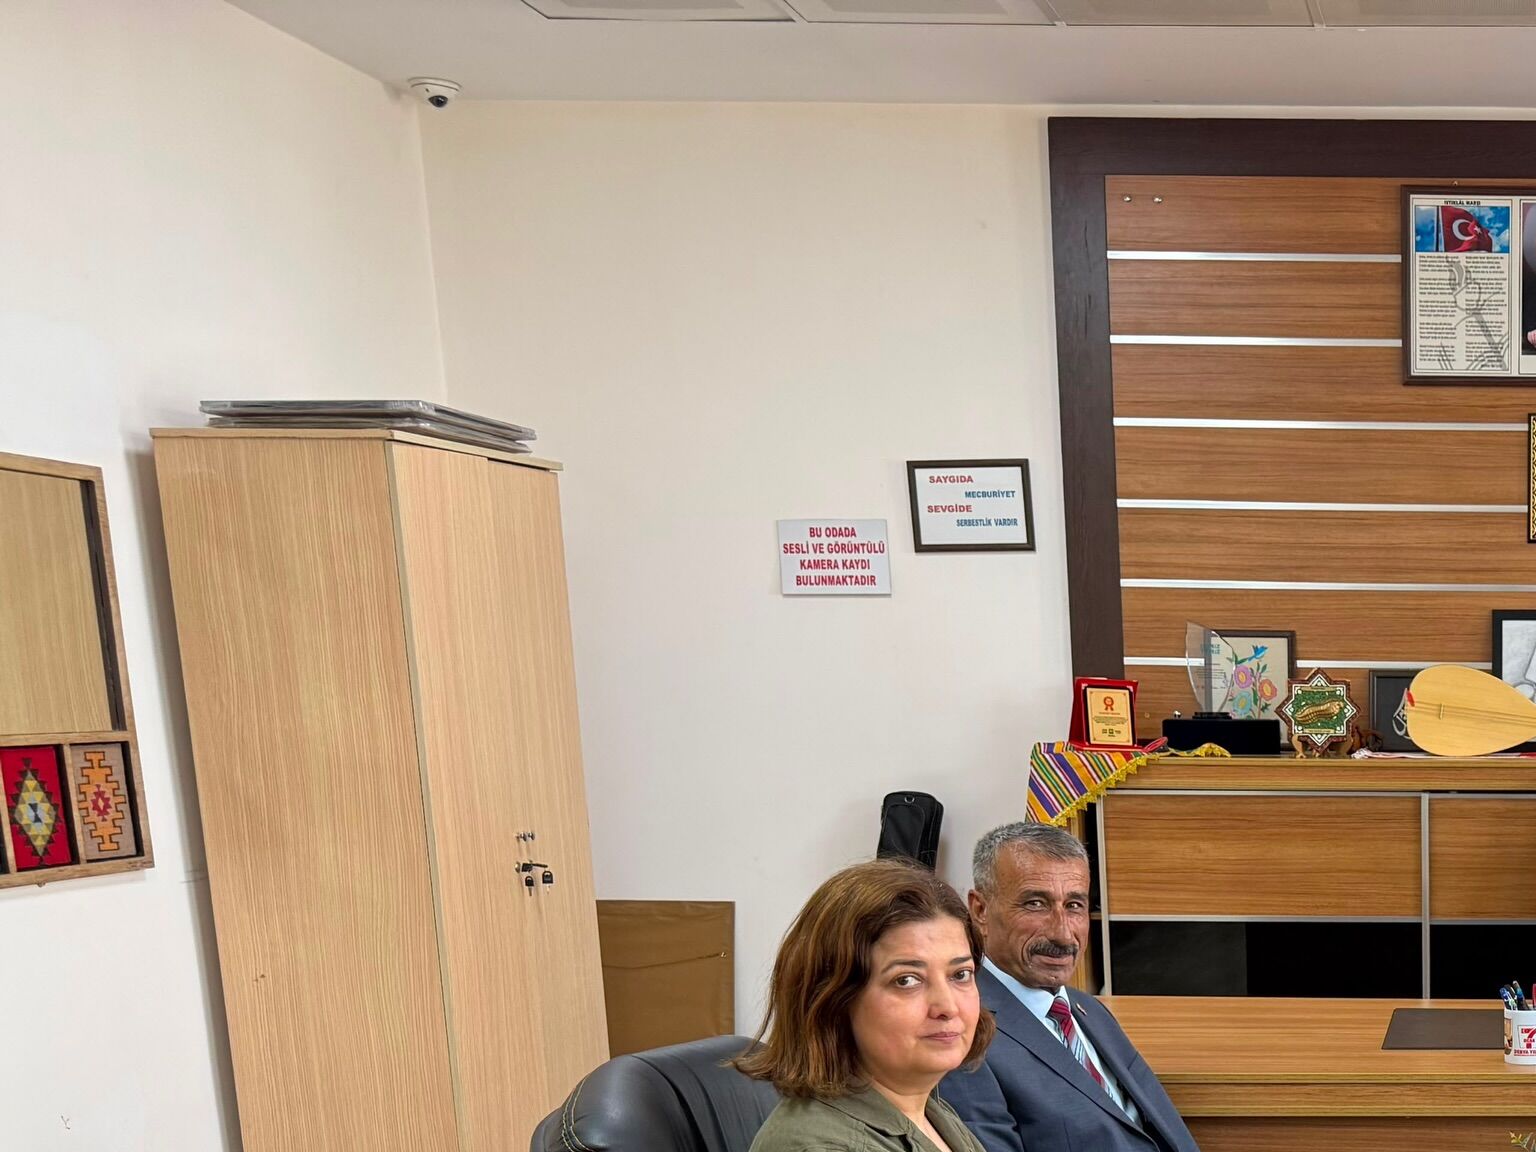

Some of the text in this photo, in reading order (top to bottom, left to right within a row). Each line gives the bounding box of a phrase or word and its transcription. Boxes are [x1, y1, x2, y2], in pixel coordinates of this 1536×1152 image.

[929, 475, 974, 484] SAYGIDA
[965, 490, 1016, 498] MECBURİYET
[927, 504, 973, 513] SEVGİDE
[956, 517, 1018, 527] SERBESTLİK VARDIR
[809, 527, 857, 538] BU ODADA
[783, 541, 885, 554] SESLİ VE GÖRÜNTÜLÜ
[800, 559, 871, 570] KAMERA KAYDI
[796, 575, 877, 586] BULUNMAKTADIR
